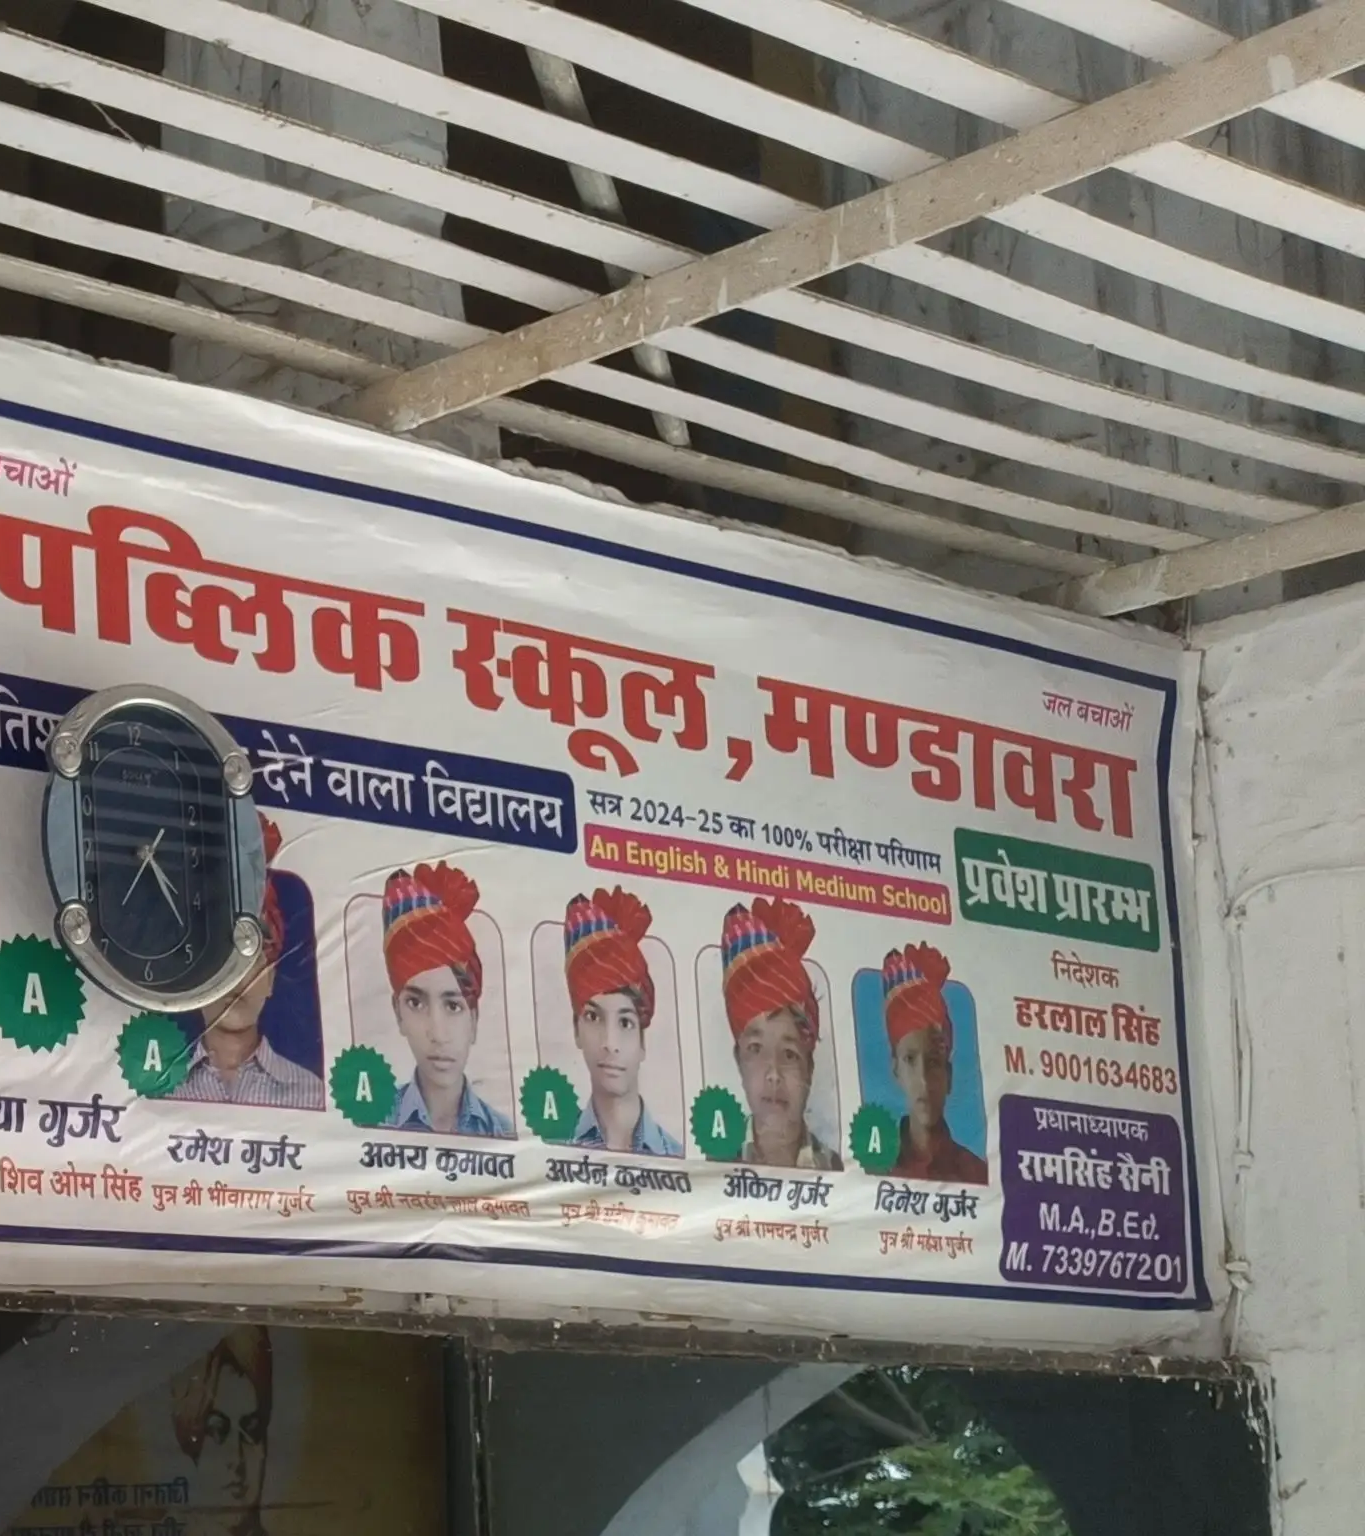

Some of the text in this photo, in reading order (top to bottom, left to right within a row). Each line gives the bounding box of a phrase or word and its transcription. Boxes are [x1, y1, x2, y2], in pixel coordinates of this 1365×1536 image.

[1042, 691, 1074, 720] जल
[89, 742, 101, 761] 11
[127, 726, 142, 747] 12
[257, 729, 313, 803] देने
[322, 758, 416, 815] वाला
[423, 759, 566, 840] विद्यालय
[188, 807, 198, 827] 2
[587, 786, 943, 876] सत्र 2024-25 का 100% परीक्षा परिणाम
[190, 848, 200, 868] 3
[589, 835, 948, 918] An English & Hindi Medium School
[960, 853, 1153, 933] प्रवेश प्रारम्भ
[144, 961, 154, 981] 6
[184, 944, 195, 964] 5
[1050, 950, 1120, 990] निदेशक
[22, 972, 48, 1016] A
[1013, 995, 1161, 1047] हरलाल सिंह
[144, 1039, 163, 1072] A
[1004, 1045, 1178, 1096] M. 9001634683
[355, 1071, 373, 1103] A
[543, 1090, 559, 1121] A
[39, 1094, 128, 1148] गुर्जर
[711, 1109, 726, 1139] A
[868, 1125, 882, 1154] A
[1033, 1106, 1150, 1143] प्रधानाध्यापक
[167, 1128, 307, 1174] रमेश गुर्जर
[359, 1141, 516, 1182] अभय कुमावत
[50, 1161, 96, 1200] ओम
[101, 1166, 143, 1204] सिंह
[614, 1164, 693, 1195] कुमावत
[723, 1168, 834, 1211] अंकित गुर्जर
[1017, 1147, 1171, 1197] रामसिंह सैनी
[151, 1184, 179, 1211] पुत्र
[182, 1178, 204, 1206] श्री
[276, 1185, 316, 1218] गुर्जर
[346, 1190, 372, 1215] पुत्र
[375, 1184, 395, 1209] श्री
[874, 1180, 980, 1222] दिनेश गुर्जर
[879, 1229, 899, 1254] पुत्र
[900, 1226, 914, 1248] श्री
[945, 1231, 973, 1259] गुर्जर
[1005, 1241, 1183, 1284] M. 7339767201
